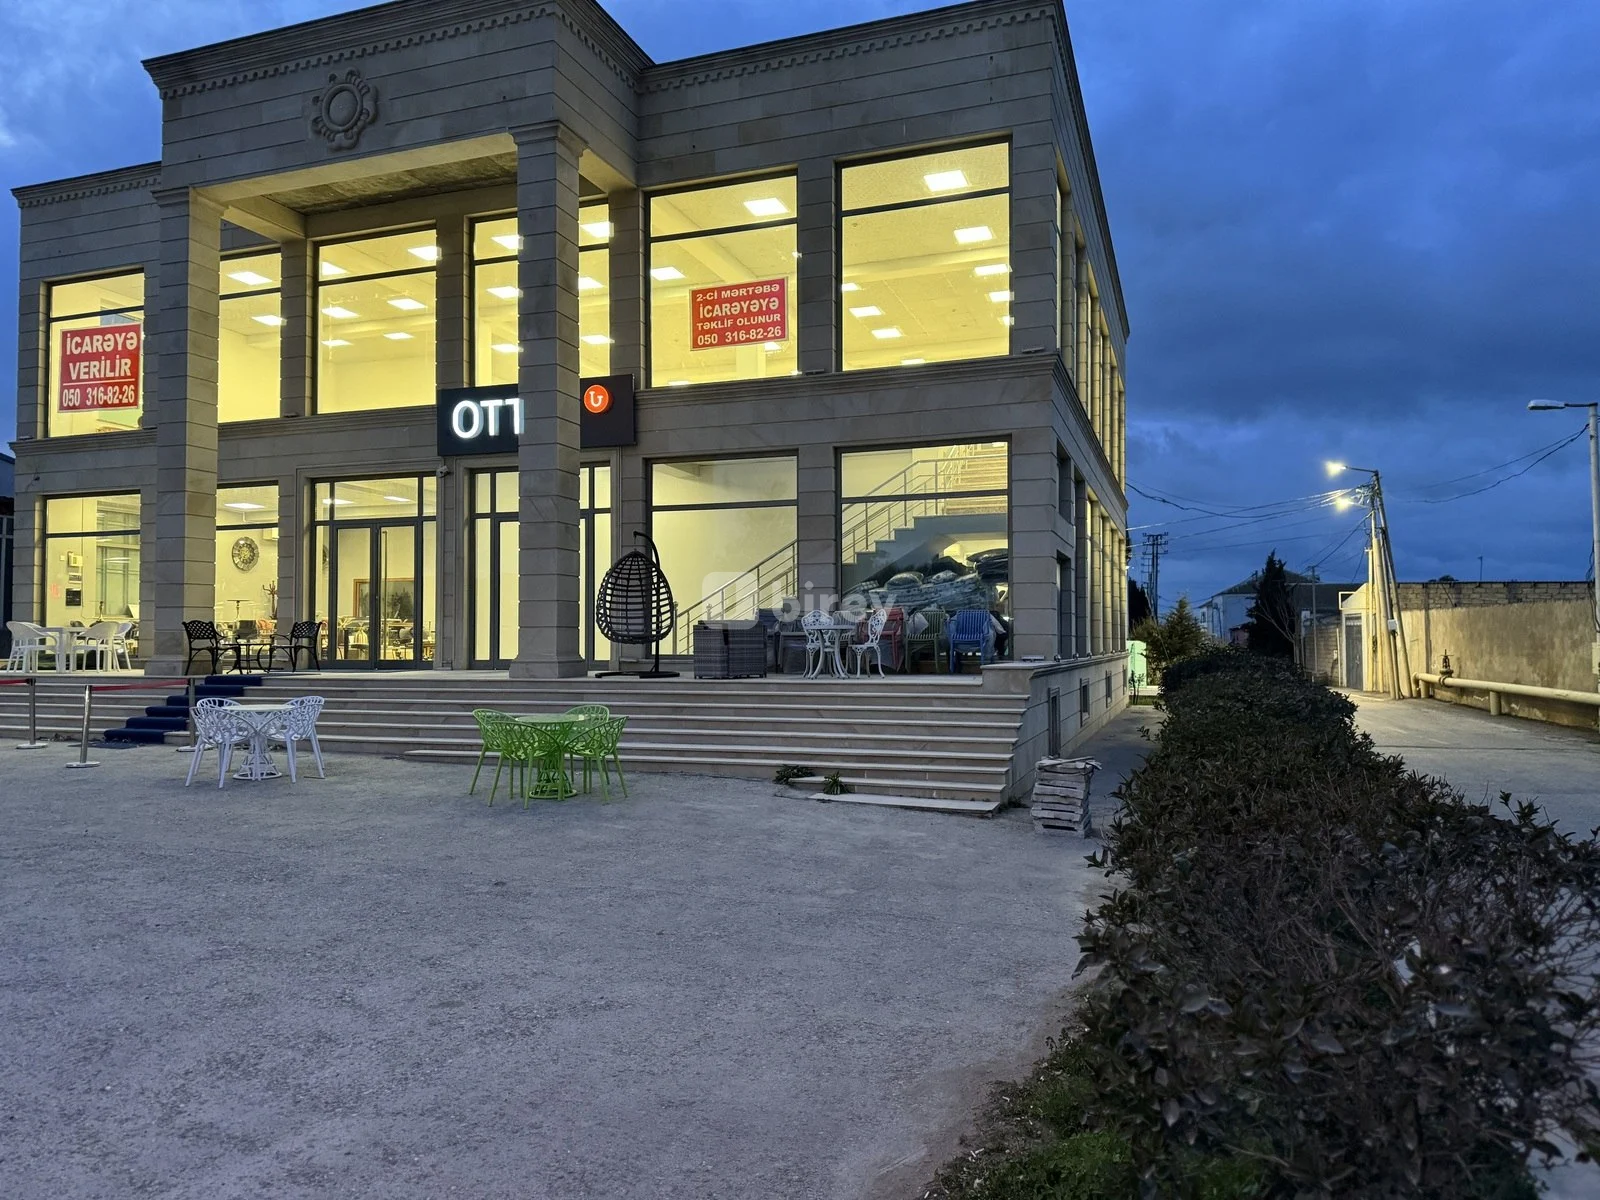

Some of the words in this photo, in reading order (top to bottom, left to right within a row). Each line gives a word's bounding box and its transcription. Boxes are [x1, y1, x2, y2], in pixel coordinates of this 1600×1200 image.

[696, 290, 718, 302] 2-Cİ
[721, 284, 780, 299] MƏRTƏBƏ
[699, 297, 779, 319] İCARƏYƏYƏ
[696, 318, 734, 331] TƏKLİF
[736, 313, 781, 326] OLUNUR
[66, 331, 138, 355] İCARƏYƏ
[697, 333, 718, 346] 050
[725, 326, 782, 343] 316-82-26
[68, 354, 132, 380] VERİLİR
[62, 388, 81, 407] 050
[86, 384, 135, 406] 316-82-26
